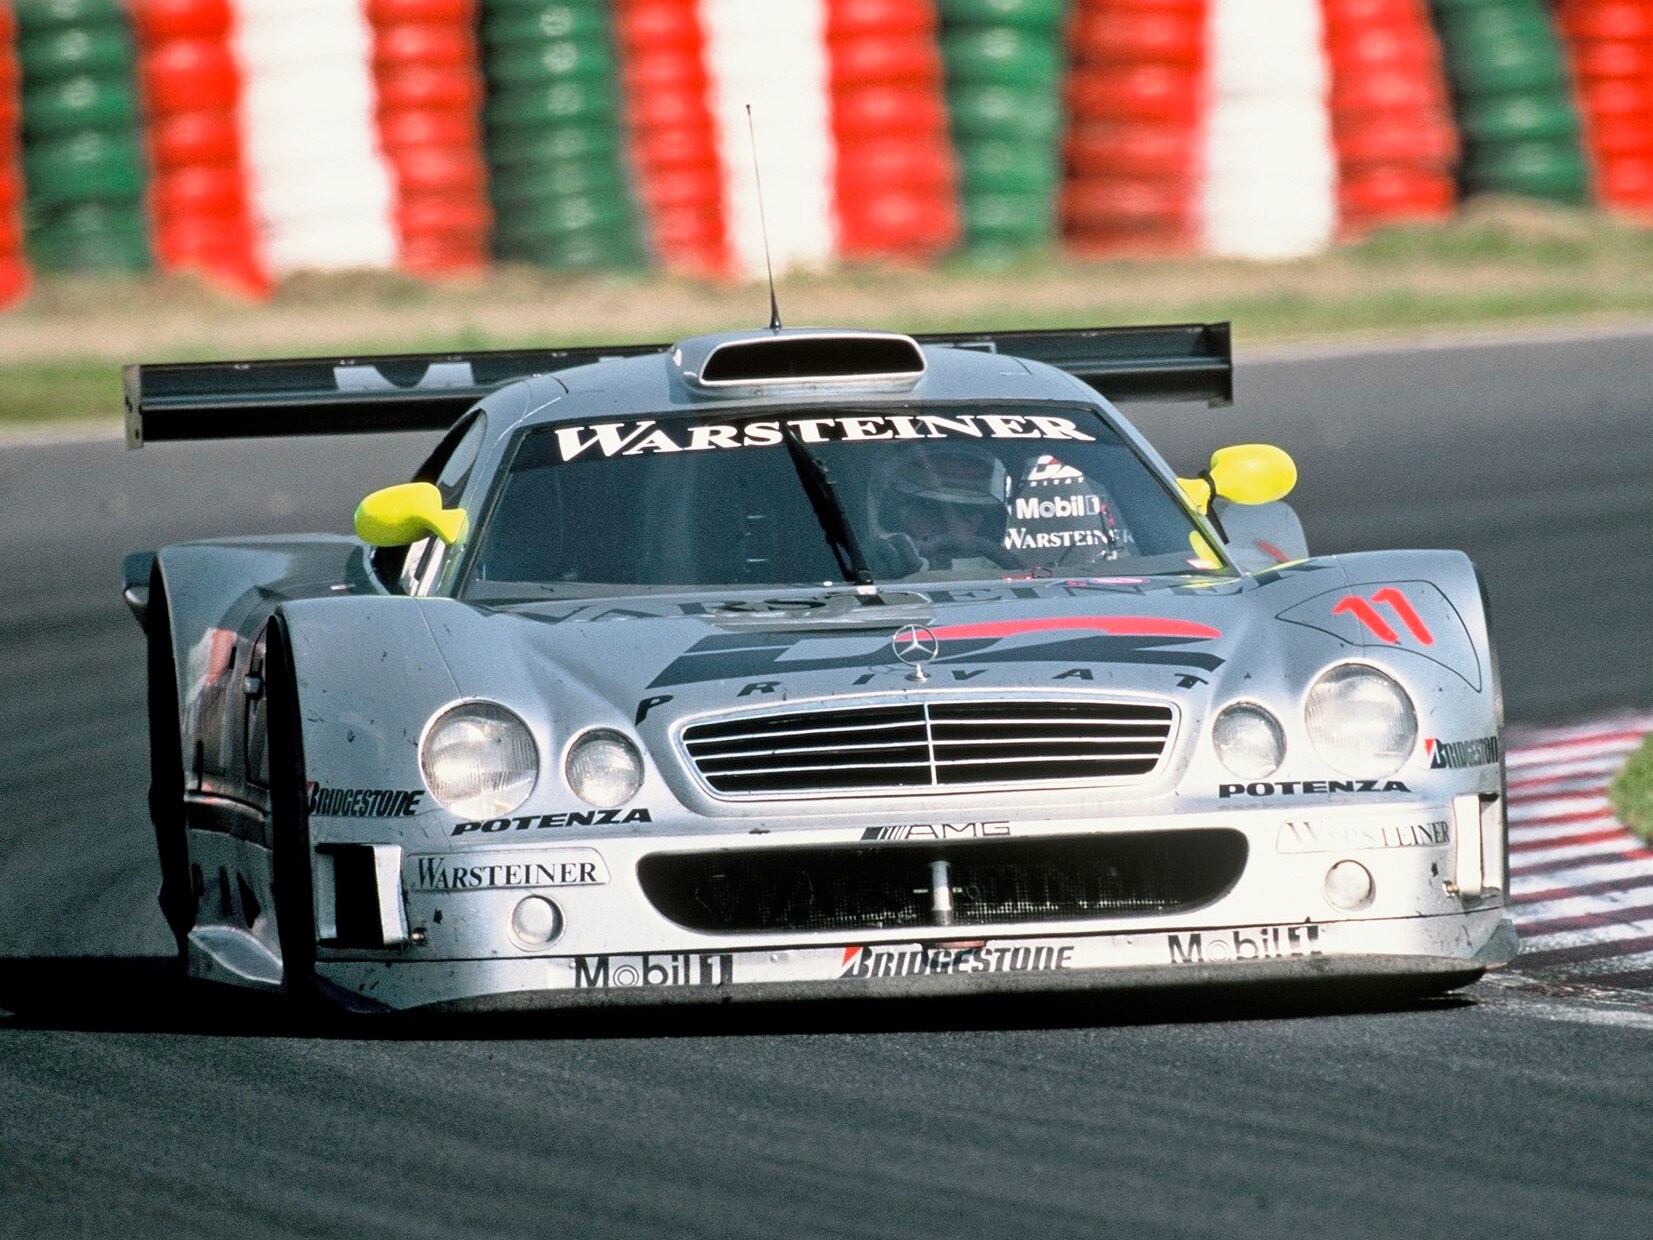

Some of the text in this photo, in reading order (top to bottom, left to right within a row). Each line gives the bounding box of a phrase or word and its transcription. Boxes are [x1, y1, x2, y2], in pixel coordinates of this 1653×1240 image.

[554, 414, 1097, 462] WARSTEINER
[1016, 495, 1084, 519] Mobil
[1331, 587, 1434, 646] 11
[635, 668, 1209, 726] PRIVAT
[307, 781, 425, 816] BRIDGESTONE
[1219, 780, 1412, 798] POTENZA
[451, 808, 652, 836] POTENZA
[904, 821, 1011, 839] AMG
[417, 857, 598, 888] WARSTEINER
[1168, 928, 1281, 963] Mobil
[575, 955, 690, 988] Mobil
[839, 946, 1075, 979] BRIDGESTONE
